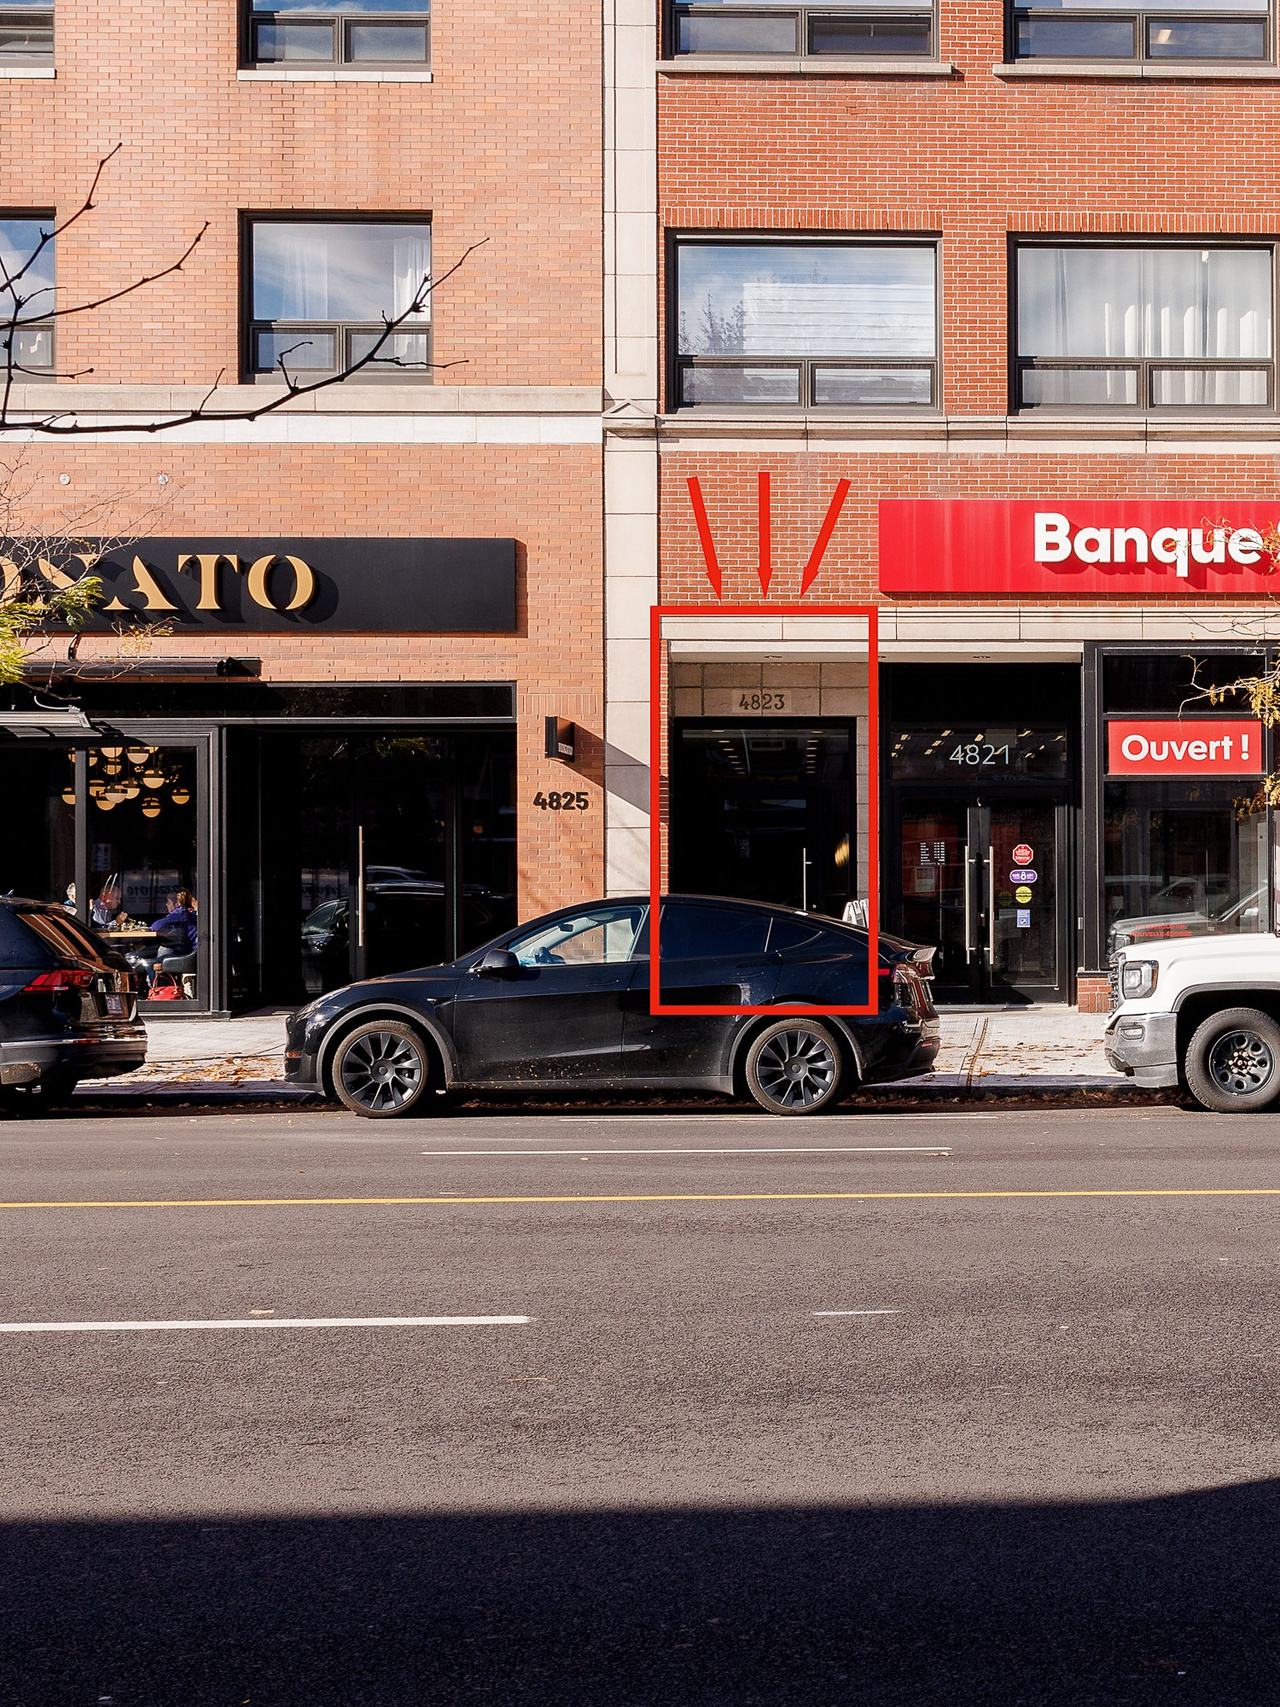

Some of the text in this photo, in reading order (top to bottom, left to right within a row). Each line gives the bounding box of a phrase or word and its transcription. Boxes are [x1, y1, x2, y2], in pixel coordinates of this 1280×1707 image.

[1034, 512, 1262, 578] Banque
[738, 694, 785, 710] 4823
[949, 744, 1010, 765] 4821
[1121, 733, 1233, 762] Ouvert
[533, 791, 589, 811] 4825
